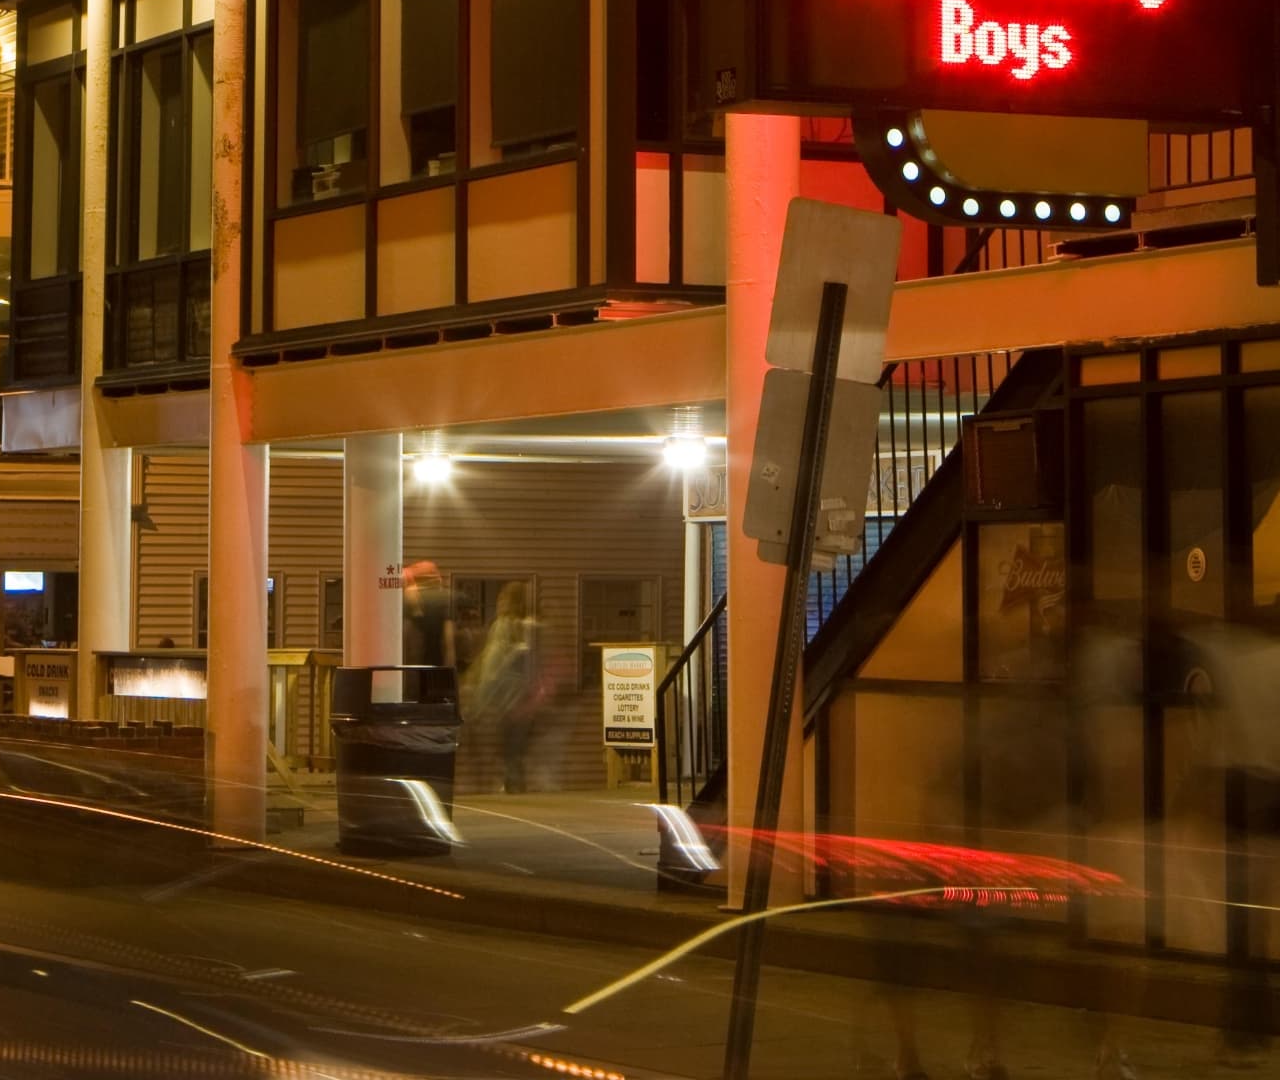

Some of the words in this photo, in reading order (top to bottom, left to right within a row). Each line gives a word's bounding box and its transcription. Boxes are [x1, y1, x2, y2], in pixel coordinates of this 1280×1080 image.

[616, 683, 630, 691] COLD
[631, 683, 650, 691] DRINKS
[613, 694, 644, 702] CIGARETTES
[617, 704, 640, 712] LOTTERY
